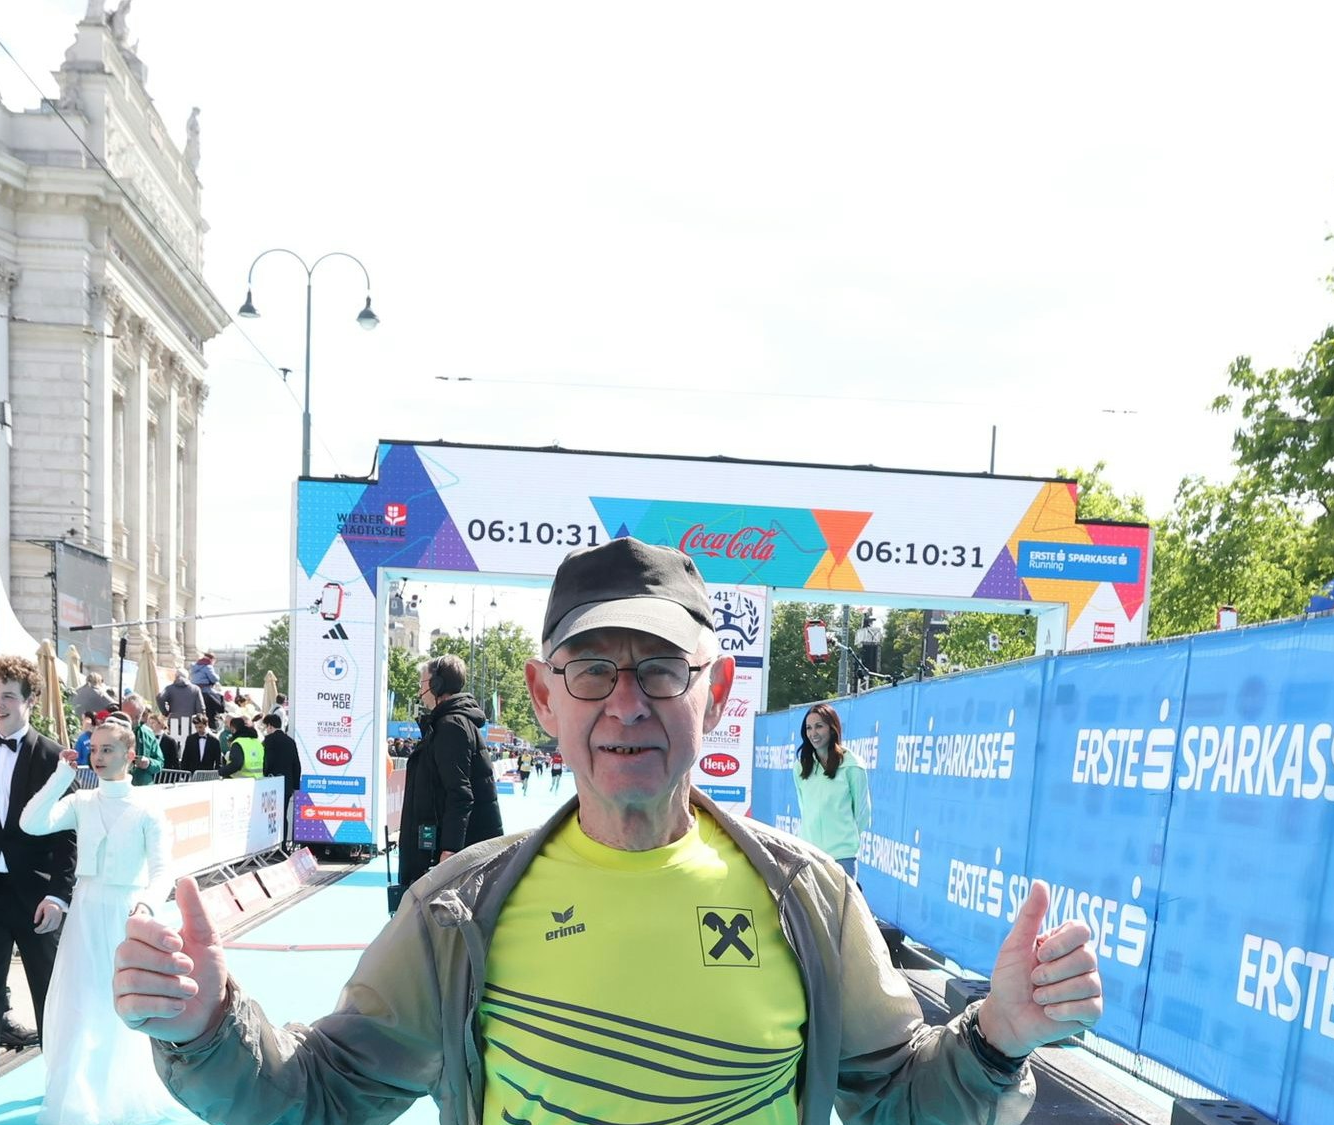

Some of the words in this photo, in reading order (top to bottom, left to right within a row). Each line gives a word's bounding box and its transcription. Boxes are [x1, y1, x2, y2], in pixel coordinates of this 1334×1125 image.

[337, 513, 383, 525] WIENER
[467, 518, 601, 547] 06:10:31
[679, 522, 779, 561] Coca-Cola
[856, 540, 984, 568] 06:10:31
[1029, 551, 1056, 561] ERSTE
[1068, 553, 1118, 565] SPARKASSE
[1029, 560, 1064, 572] Running
[719, 638, 745, 651] CM
[317, 692, 351, 701] POWER
[319, 749, 349, 762] Hervis
[933, 733, 999, 778] SPARKASSE
[1072, 728, 1144, 788] ERSTE
[703, 757, 737, 772] Hervis
[947, 858, 988, 913] ERSTE
[546, 923, 586, 942] erima
